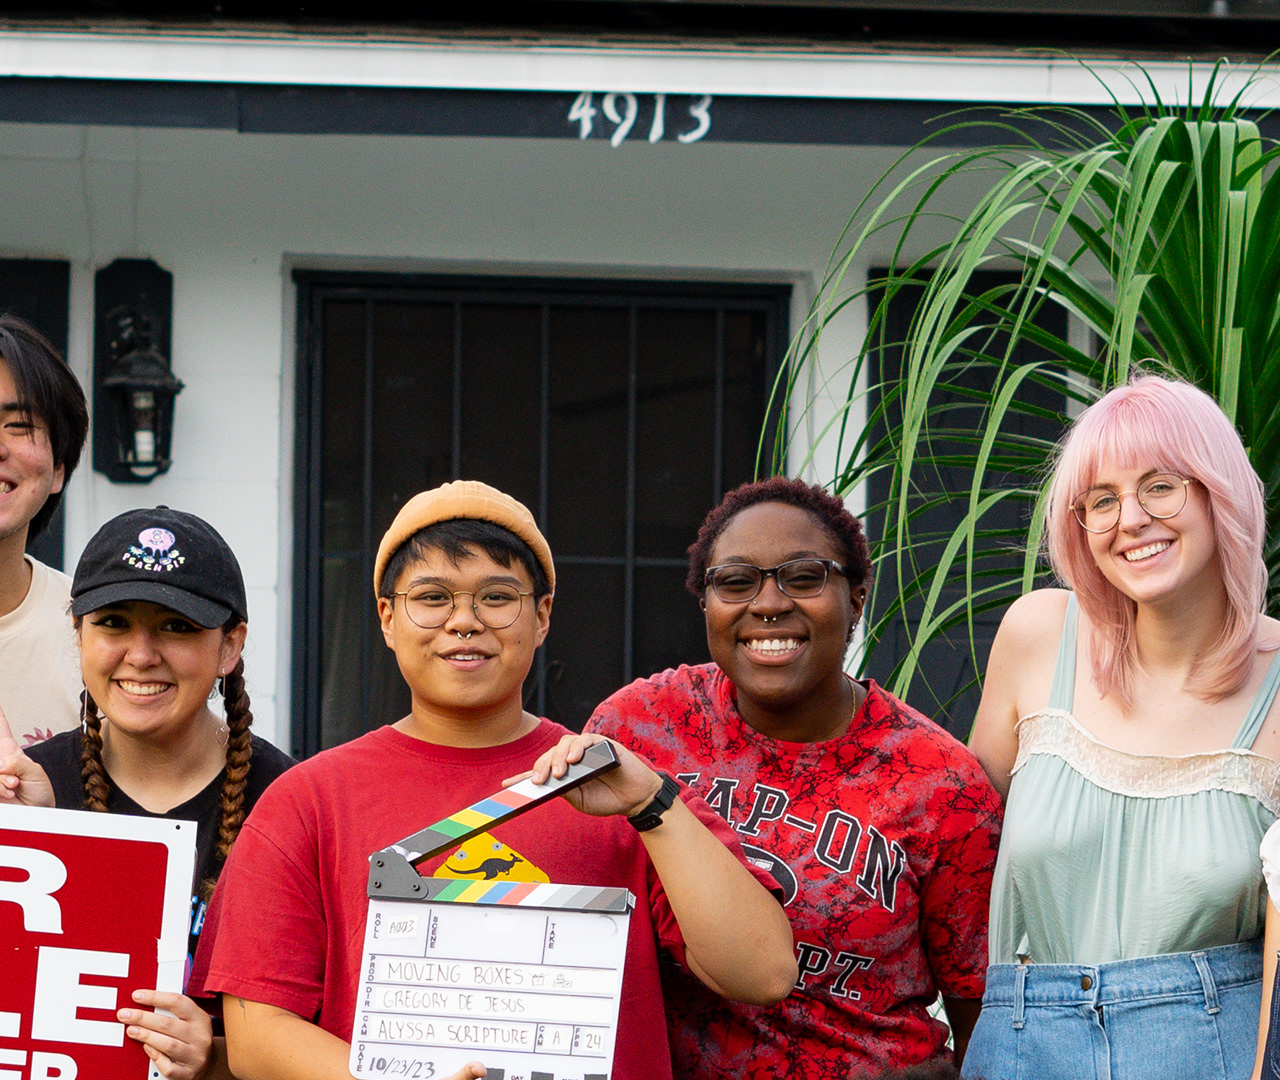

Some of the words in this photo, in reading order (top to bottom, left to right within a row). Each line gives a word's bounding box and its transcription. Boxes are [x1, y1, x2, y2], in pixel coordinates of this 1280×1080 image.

[568, 91, 712, 148] 4913
[122, 552, 163, 572] PEACH
[166, 556, 186, 572] PIT
[675, 772, 907, 914] AP-ON
[373, 913, 381, 939] ROLL
[429, 916, 438, 949] SCENE
[548, 922, 557, 950] TAKE
[367, 955, 376, 982] PROD
[388, 962, 461, 982] MOVING
[474, 965, 524, 985] BOXES
[793, 942, 875, 1001] PT.
[364, 986, 373, 1007] DIR
[383, 990, 449, 1009] GREGORY
[458, 993, 474, 1011] DE
[484, 996, 526, 1013] JESUS
[360, 1015, 369, 1036] CAM
[378, 1019, 436, 1041] ALYSSA
[447, 1024, 529, 1045] SCRIPTURE
[536, 1025, 545, 1046] CAM
[552, 1030, 561, 1046] A
[573, 1027, 581, 1048] FPS
[585, 1033, 602, 1049] 24
[356, 1044, 366, 1072] DATE
[369, 1057, 436, 1080] 10/23/23
